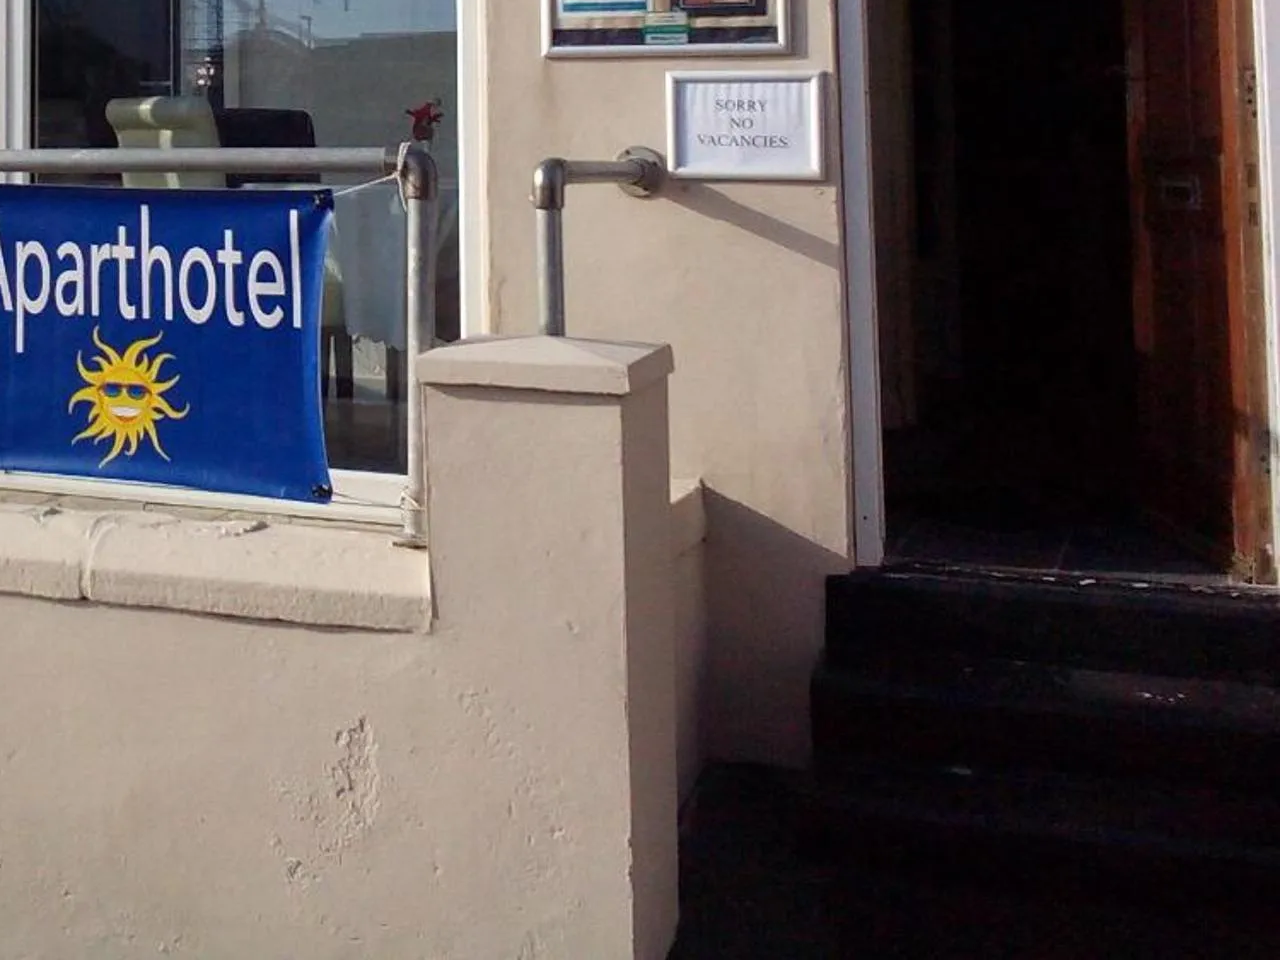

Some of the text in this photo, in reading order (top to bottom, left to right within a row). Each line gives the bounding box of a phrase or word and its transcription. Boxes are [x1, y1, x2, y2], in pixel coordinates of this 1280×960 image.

[714, 98, 767, 113] SORRY
[730, 117, 754, 130] NO
[697, 133, 789, 149] VACANCIES
